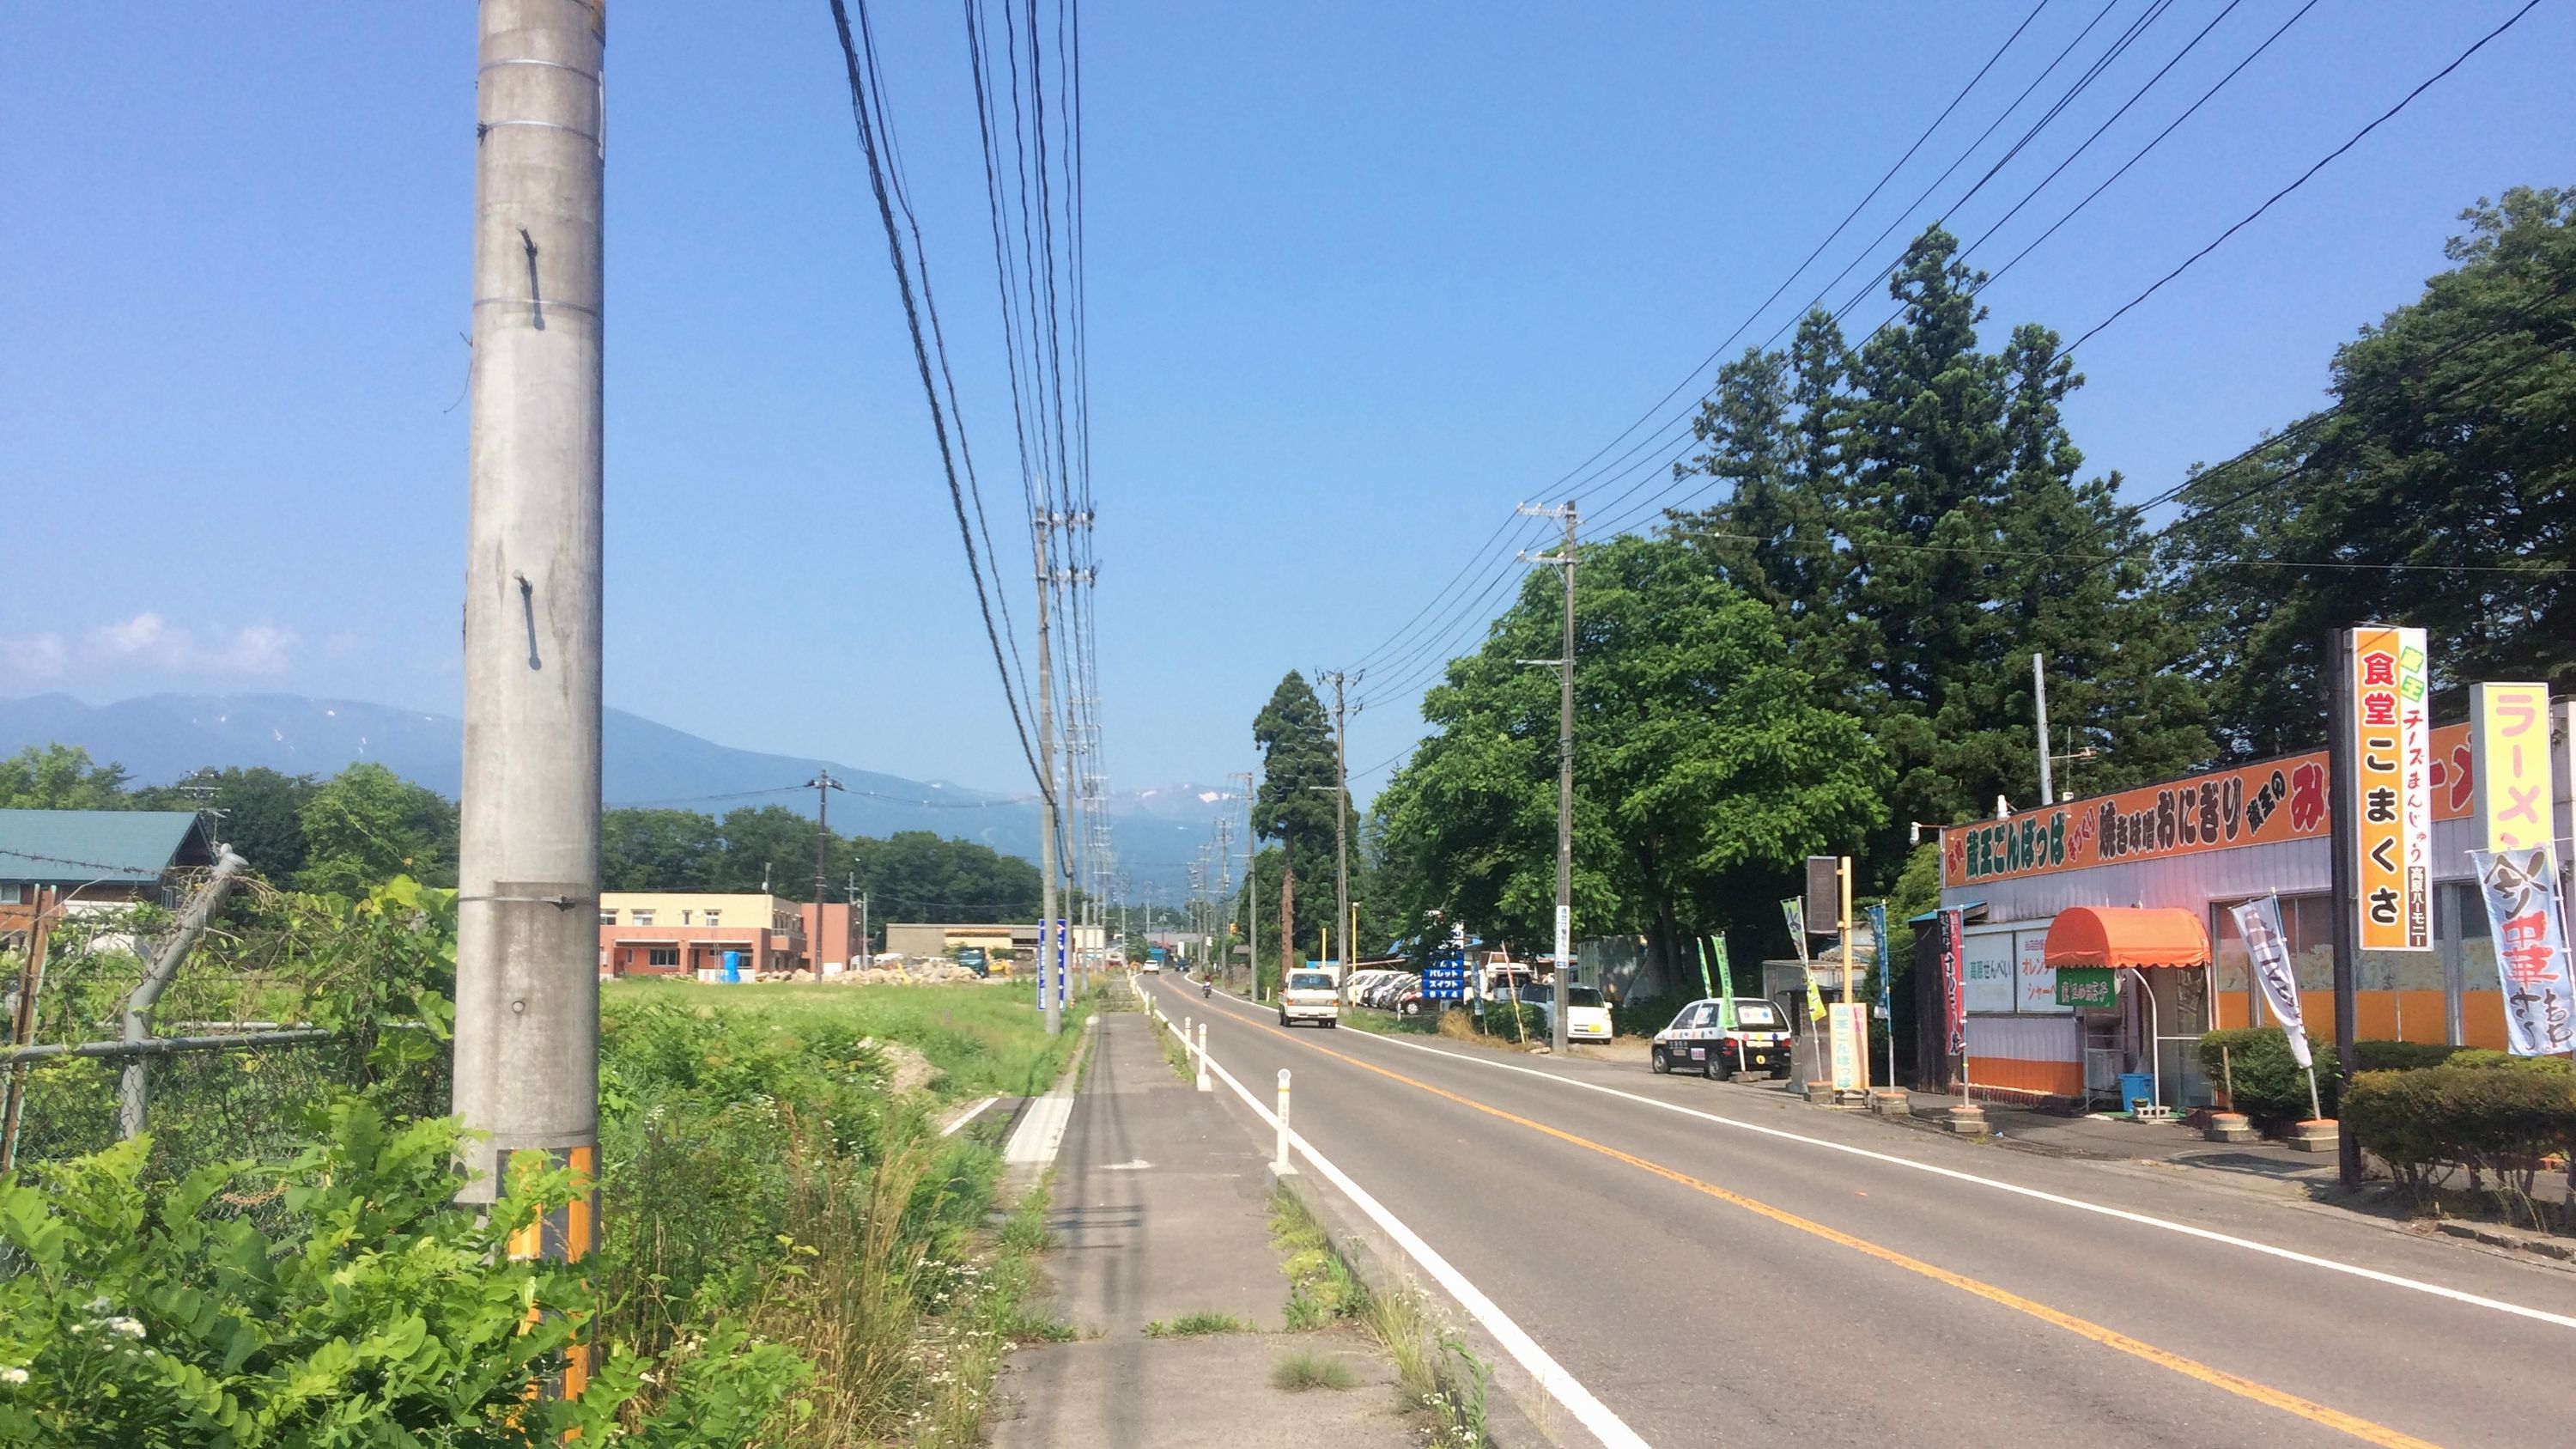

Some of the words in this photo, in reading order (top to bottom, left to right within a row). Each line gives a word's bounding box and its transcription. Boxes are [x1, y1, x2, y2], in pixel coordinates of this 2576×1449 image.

[2363, 652, 2399, 924] 食堂こまくさ
[2410, 868, 2426, 947] 高原ハーモニー
